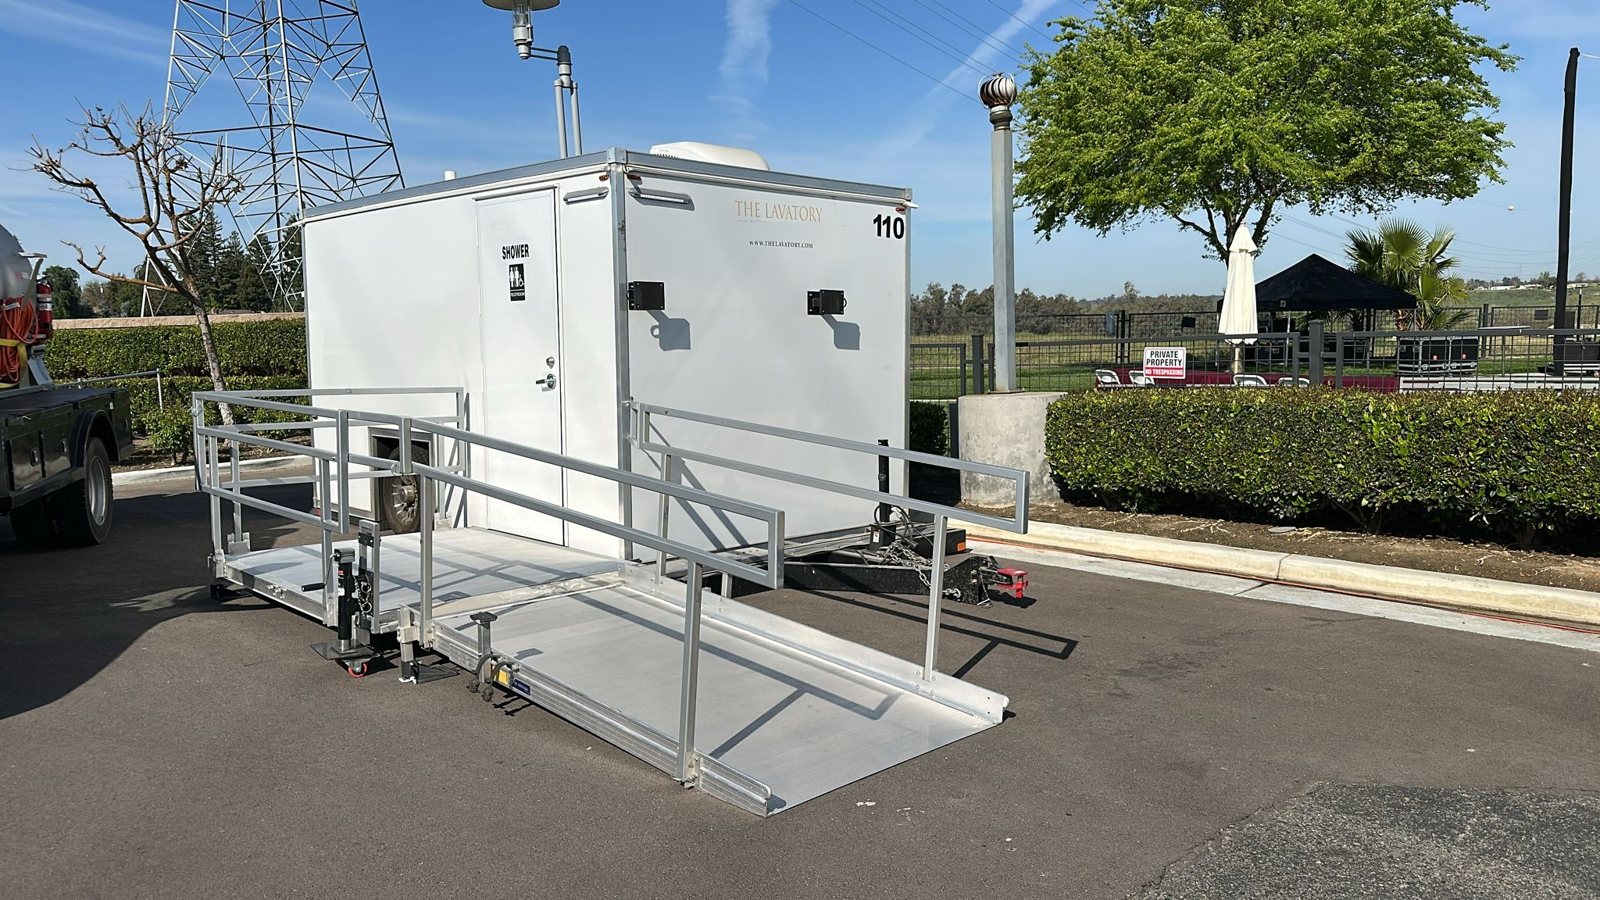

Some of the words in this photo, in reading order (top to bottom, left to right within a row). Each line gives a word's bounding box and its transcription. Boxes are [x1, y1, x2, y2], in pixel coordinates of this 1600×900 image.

[735, 200, 760, 217] THE
[765, 203, 823, 222] LAVATORY
[873, 214, 905, 239] 110
[502, 243, 530, 260] SHOWER
[1146, 358, 1183, 367] PROPERTY
[1150, 350, 1179, 358] PRIVATE
